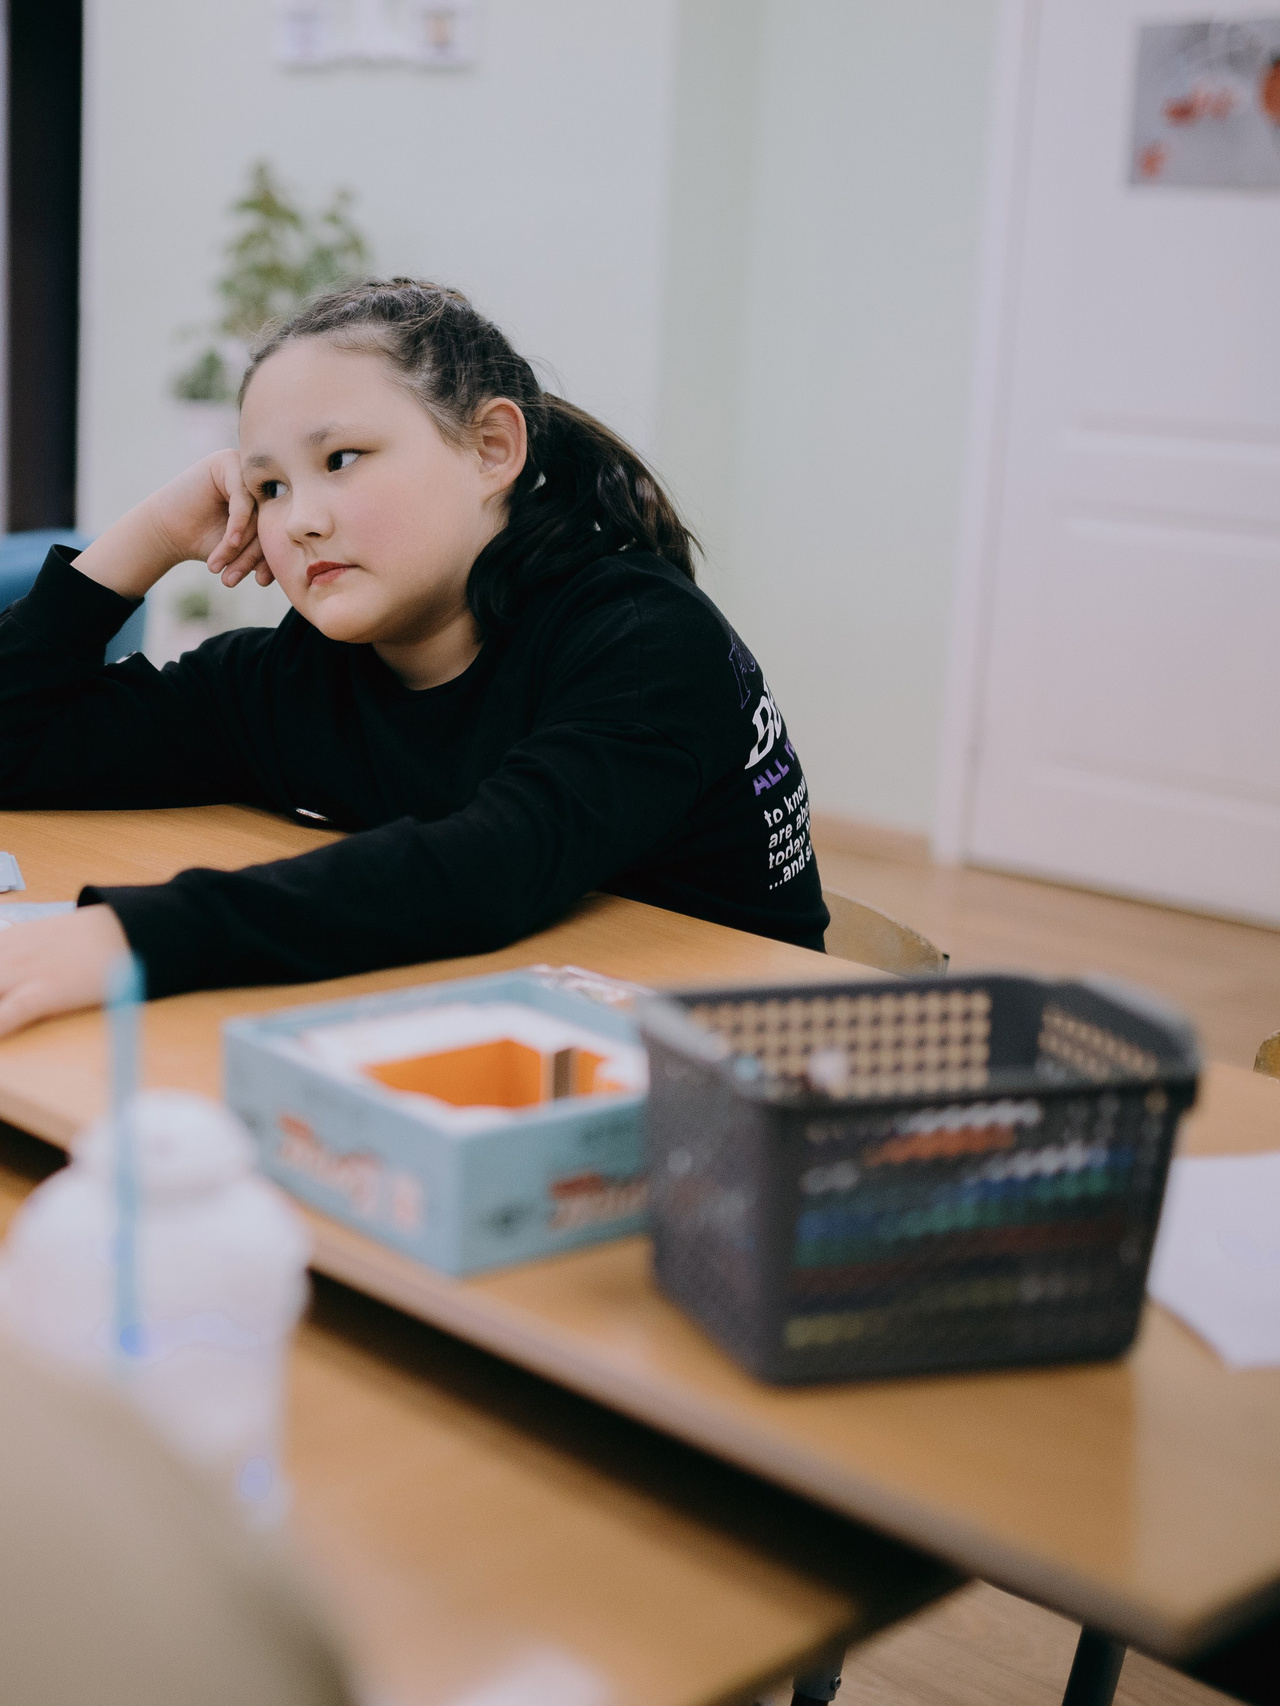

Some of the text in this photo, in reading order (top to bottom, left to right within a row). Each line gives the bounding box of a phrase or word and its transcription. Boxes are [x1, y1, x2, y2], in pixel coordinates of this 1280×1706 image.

[753, 758, 790, 796] ALL
[763, 808, 784, 828] to
[768, 823, 793, 849] are
[768, 830, 805, 870] today
[768, 849, 806, 891] ...and
